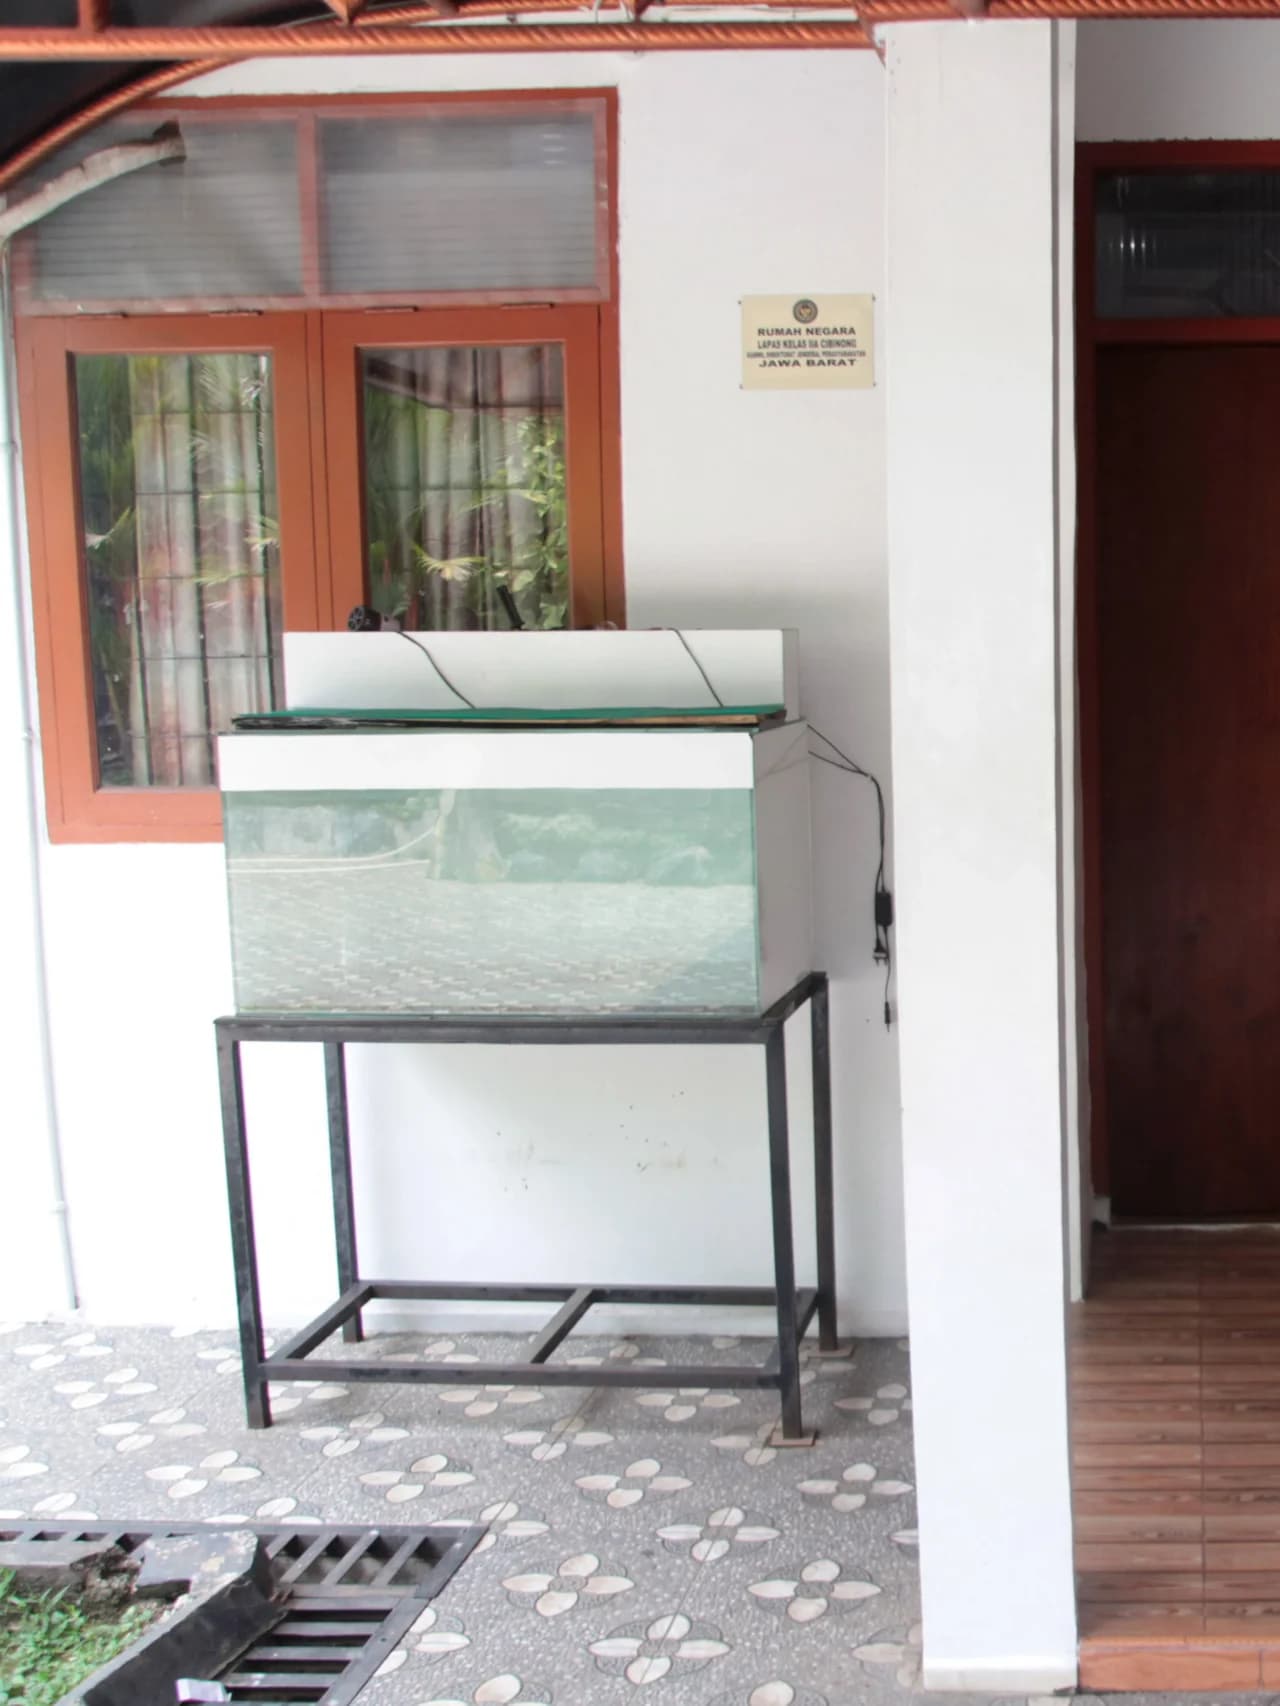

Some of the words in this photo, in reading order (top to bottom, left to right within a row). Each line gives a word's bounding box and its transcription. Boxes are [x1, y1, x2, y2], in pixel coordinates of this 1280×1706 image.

[757, 327, 802, 336] RUMAH
[806, 327, 857, 336] NEGARA
[757, 339, 781, 349] LAPAS
[783, 339, 806, 349] KELAS
[758, 359, 801, 368] JAWA
[806, 358, 857, 367] BARAT
